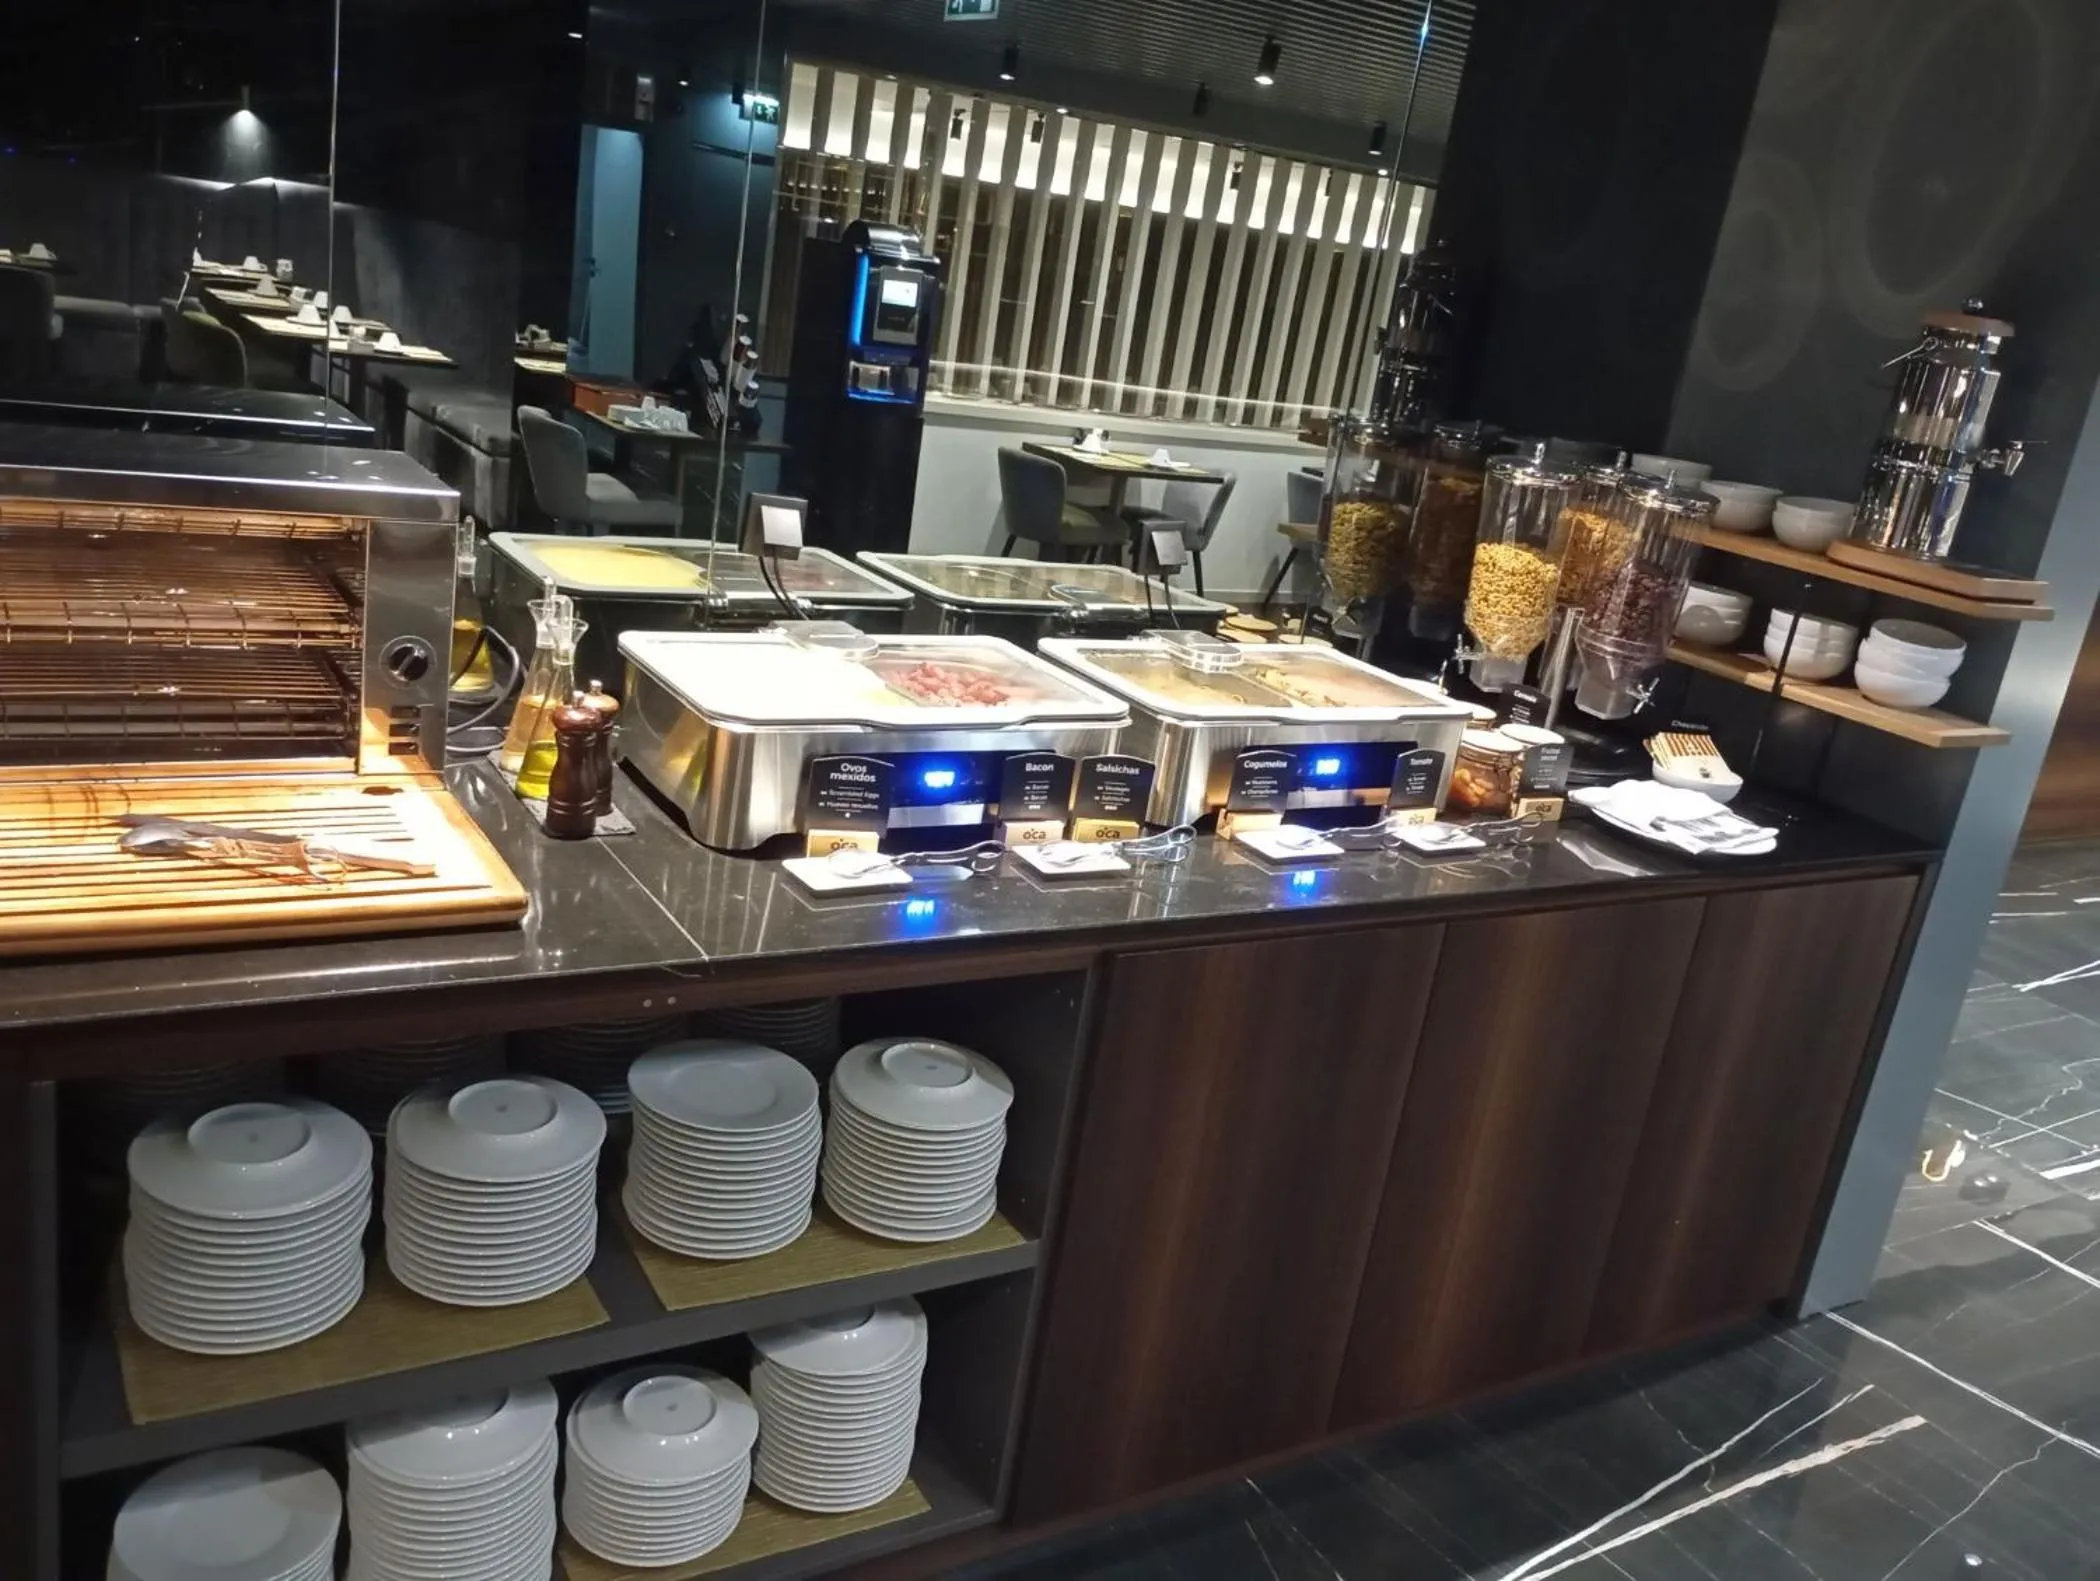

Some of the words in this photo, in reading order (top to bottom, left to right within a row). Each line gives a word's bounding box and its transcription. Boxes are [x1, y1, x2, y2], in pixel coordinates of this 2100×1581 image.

[840, 762, 867, 774] Ovos
[1025, 762, 1055, 772] Bacon
[1095, 763, 1141, 775] Salsichas
[1243, 760, 1288, 770] Cogumelos
[829, 772, 877, 783] mexidos
